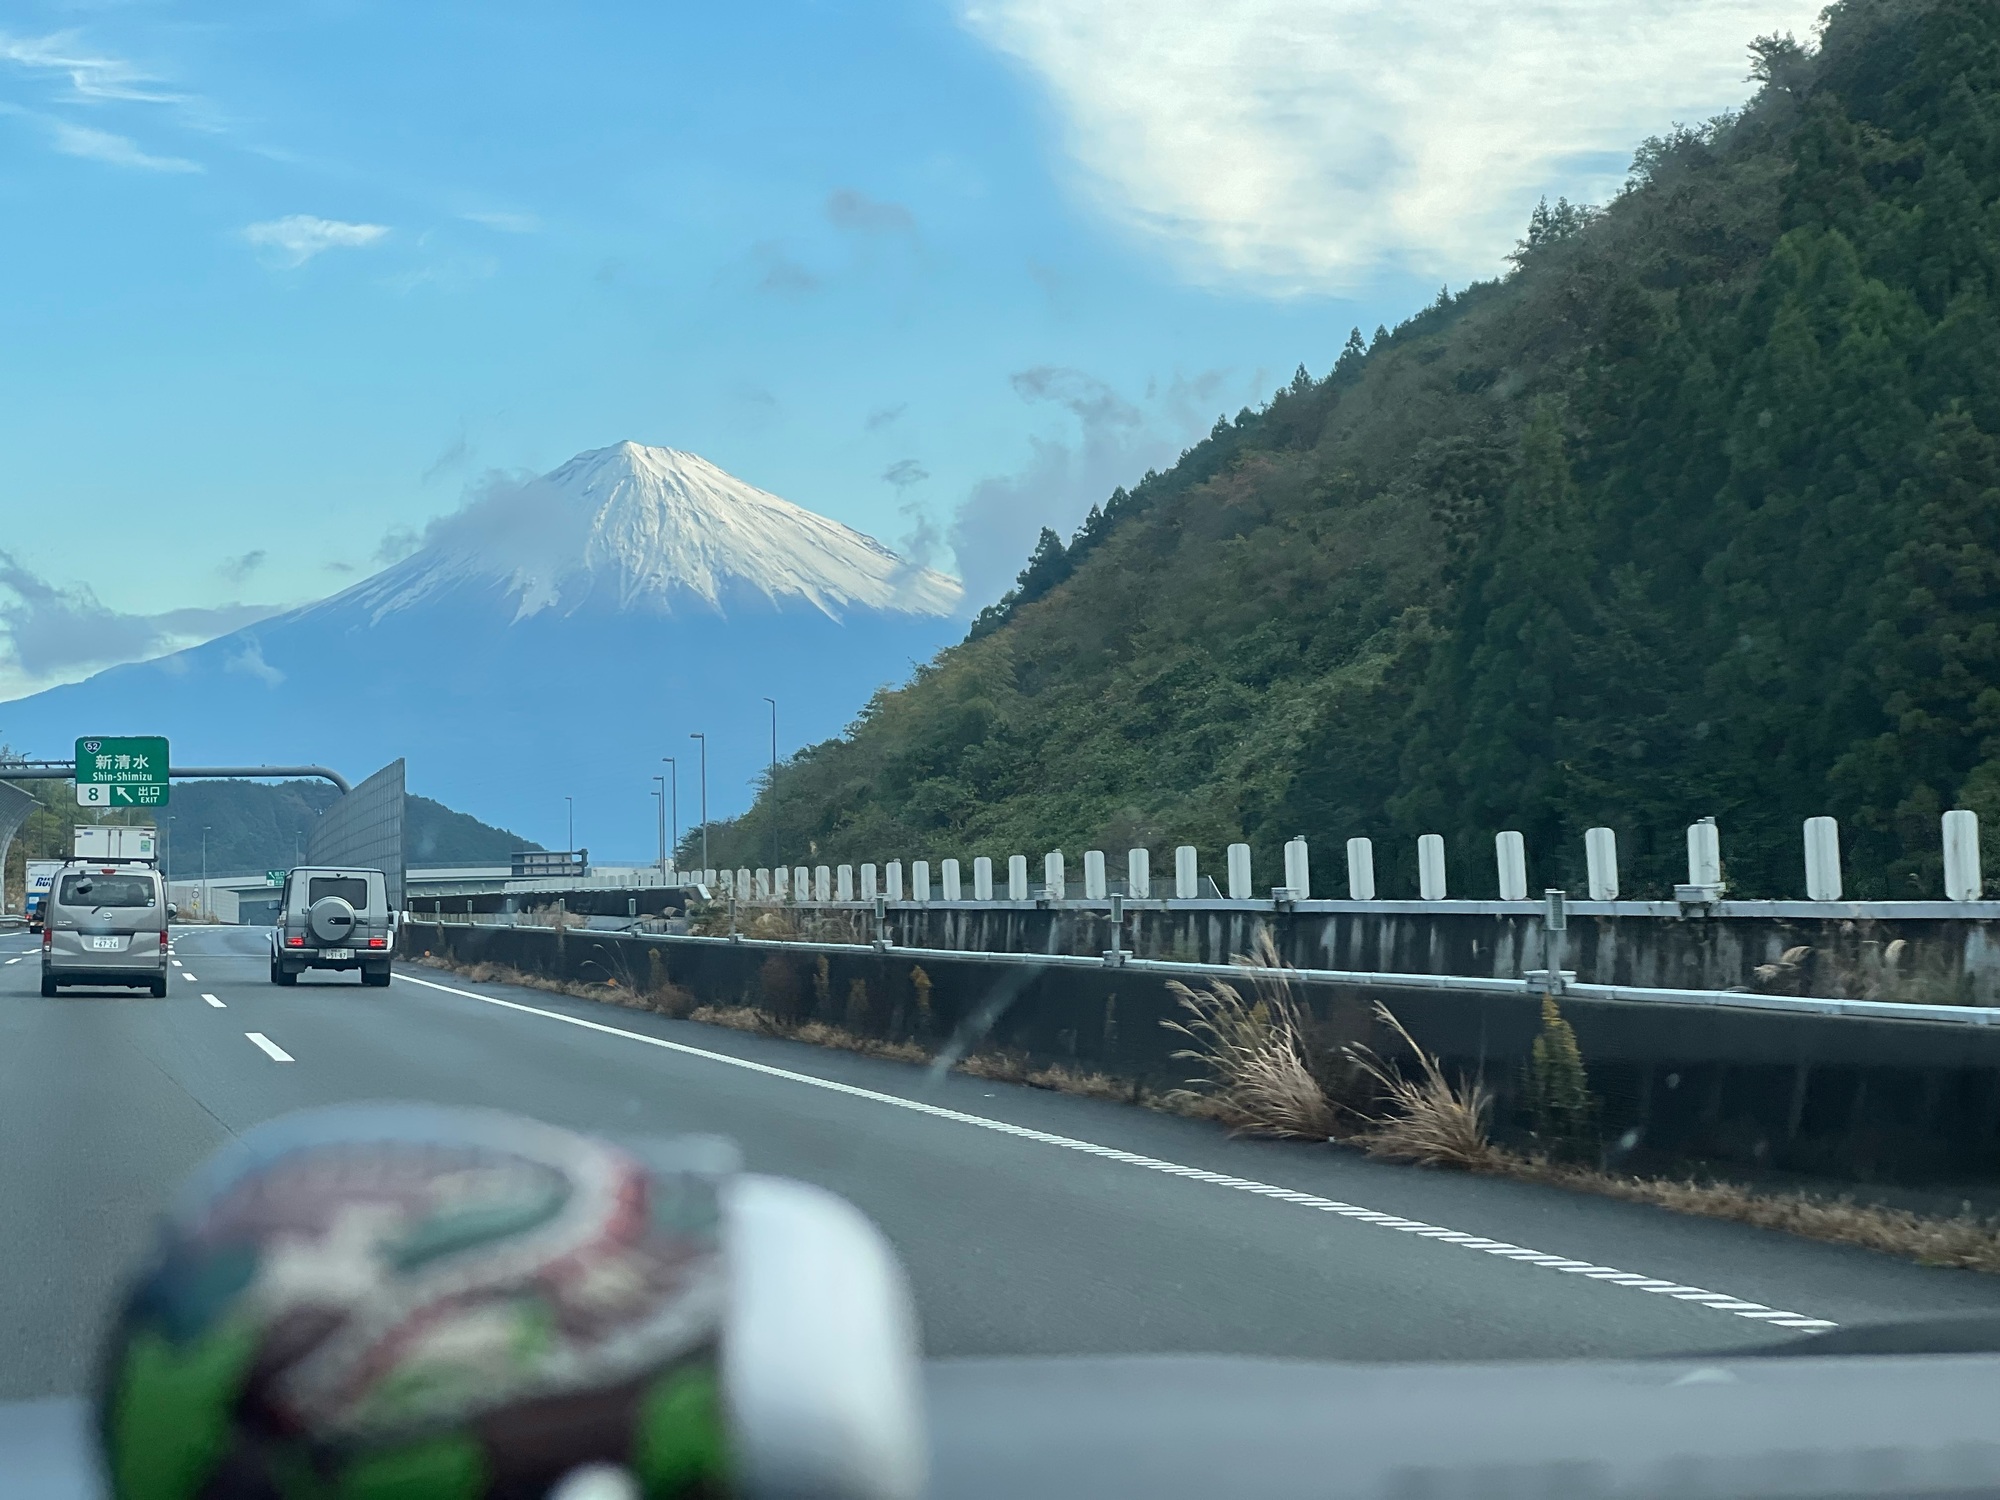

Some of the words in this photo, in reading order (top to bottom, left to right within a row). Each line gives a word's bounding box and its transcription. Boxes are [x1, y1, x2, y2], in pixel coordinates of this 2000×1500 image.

[95, 754, 149, 770] 新清水
[92, 772, 153, 781] Shin-Shimizu
[88, 787, 99, 801] 8
[138, 786, 160, 796] 出口
